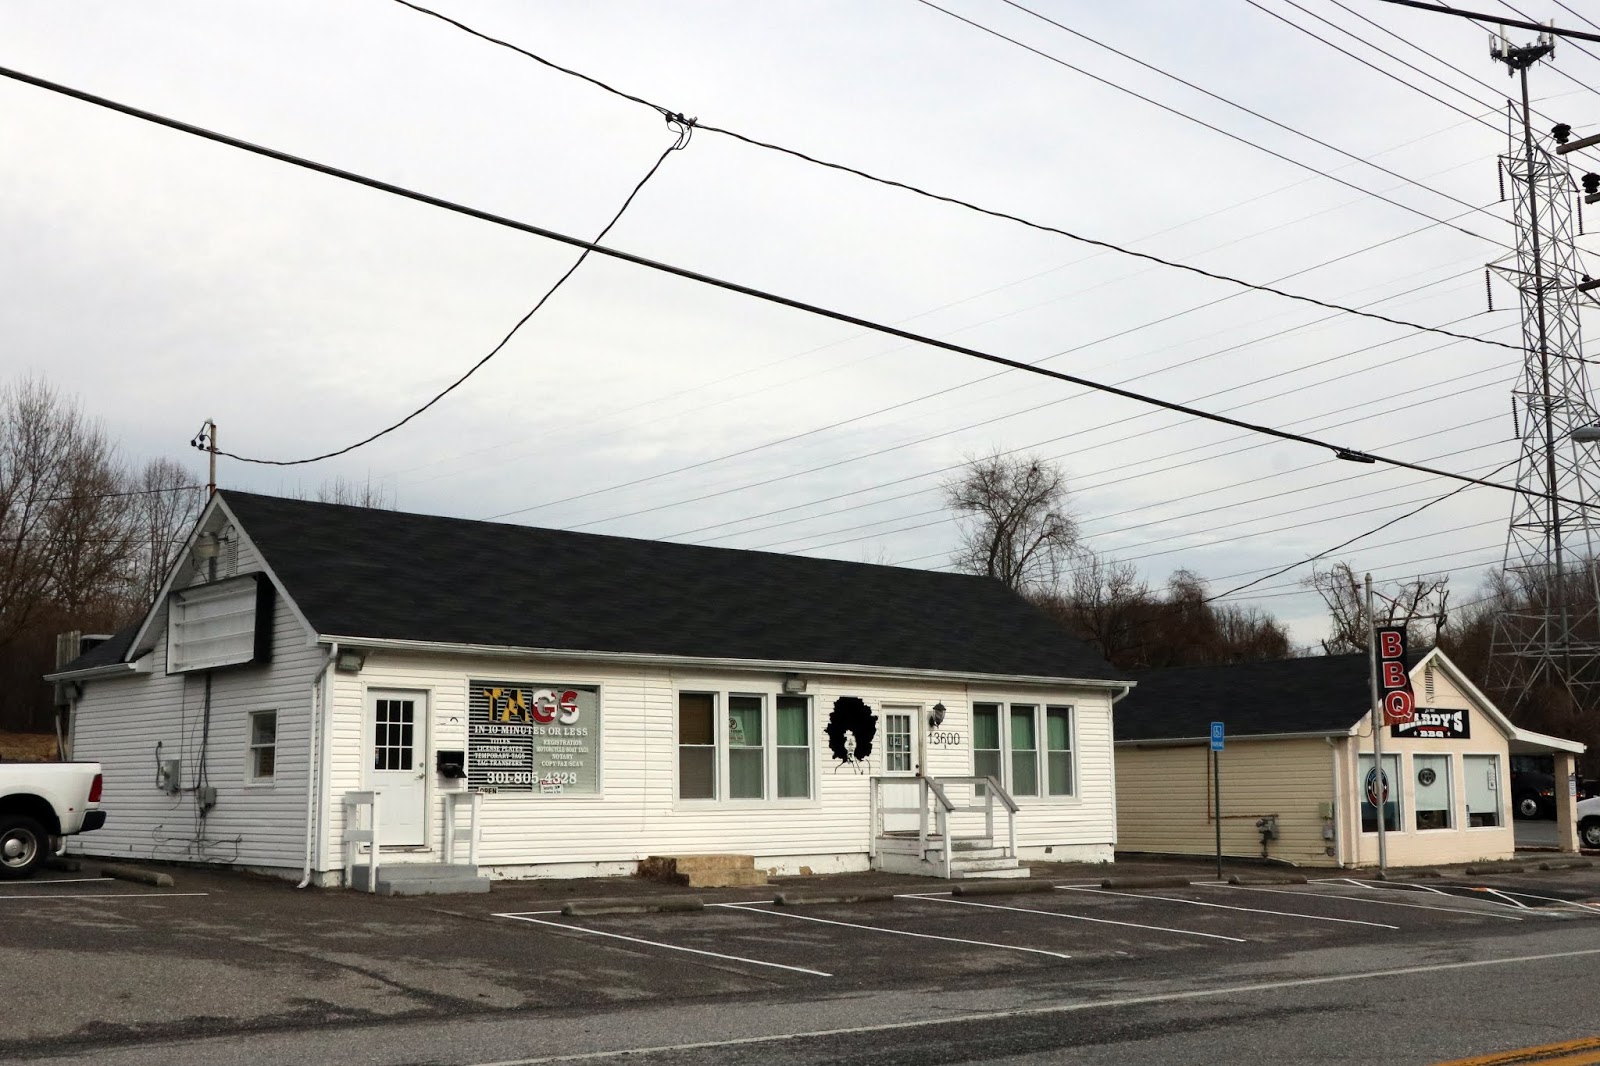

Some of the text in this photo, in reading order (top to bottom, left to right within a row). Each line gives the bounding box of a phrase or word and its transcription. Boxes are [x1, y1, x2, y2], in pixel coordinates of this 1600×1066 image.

[1380, 631, 1414, 719] BBQ
[483, 688, 580, 725] TAGS
[474, 725, 588, 736] IN 10 MINUTES OR LESS
[1399, 711, 1463, 733] ARDY'S
[928, 732, 960, 745] 13600
[1420, 730, 1444, 738] BBQ
